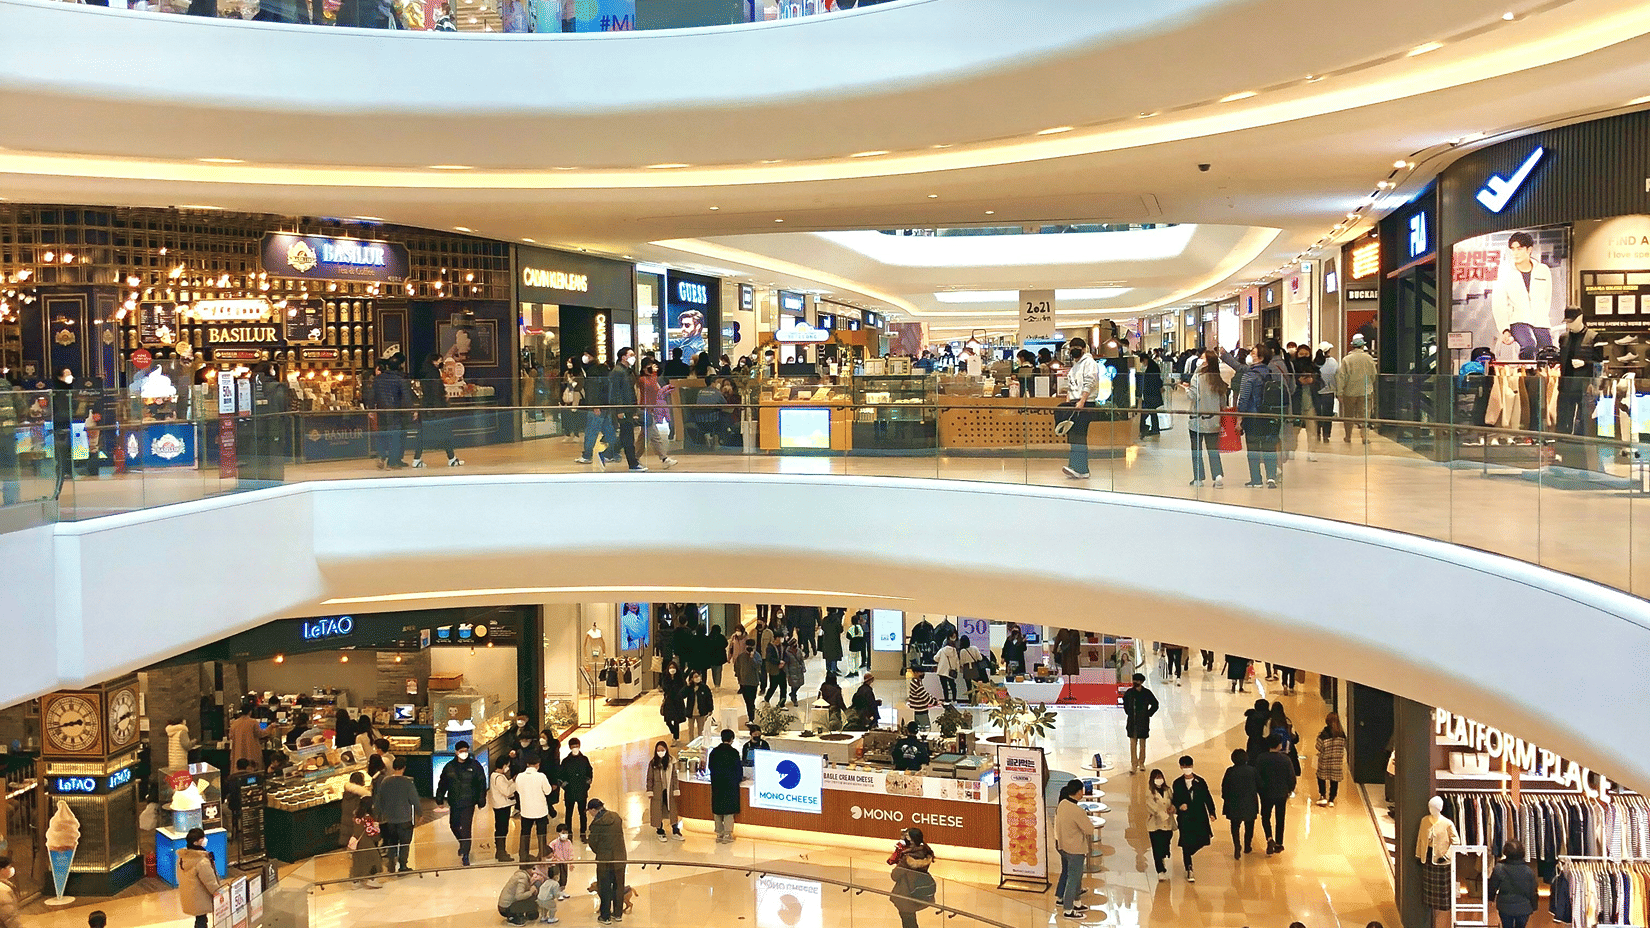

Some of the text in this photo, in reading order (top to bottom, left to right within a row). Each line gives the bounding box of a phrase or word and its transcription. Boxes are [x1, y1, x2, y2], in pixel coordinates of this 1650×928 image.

[1608, 235, 1637, 246] FIND
[322, 242, 386, 266] BASILUR
[678, 281, 708, 305] GUESS
[1026, 301, 1051, 314] 2021
[208, 327, 279, 343] BASILUR
[304, 616, 354, 639] LeTAO
[963, 619, 988, 635] 50
[1435, 707, 1612, 804] PLATFORM PLACE
[58, 778, 96, 792] LeTAO
[759, 791, 818, 805] MONO CHEESE
[863, 807, 964, 828] MONO CHEESE
